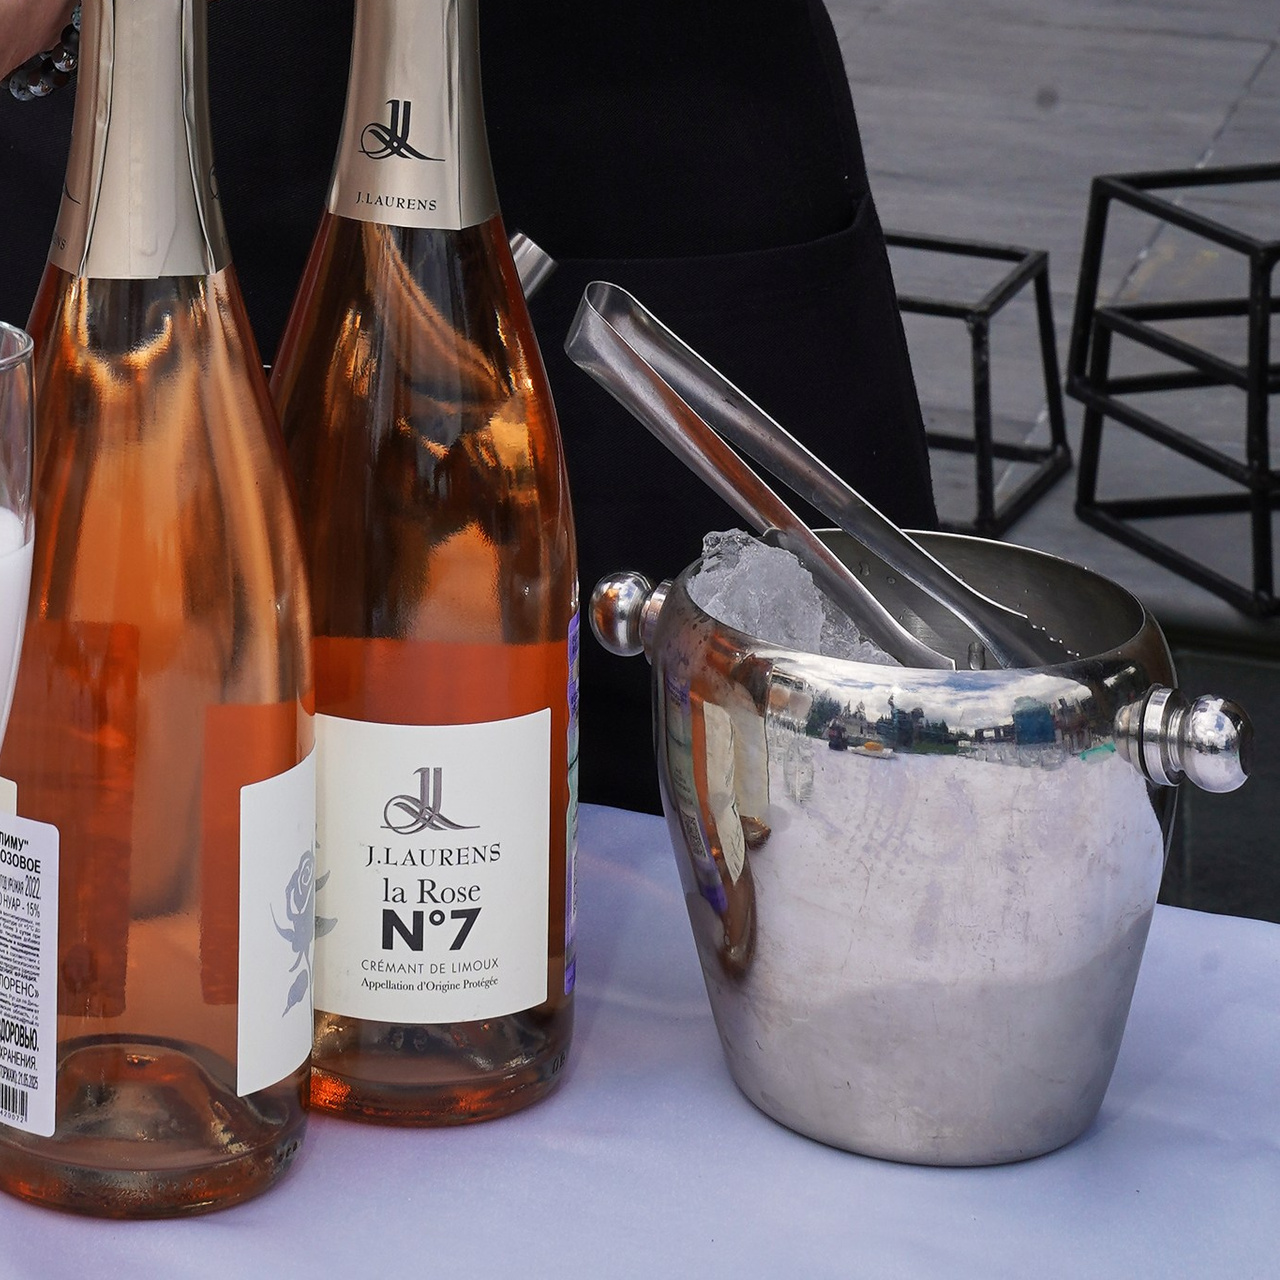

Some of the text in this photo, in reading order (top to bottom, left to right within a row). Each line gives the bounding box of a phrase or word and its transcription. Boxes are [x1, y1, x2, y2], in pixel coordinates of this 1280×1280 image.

[355, 191, 438, 211] J.LAURENS
[365, 842, 501, 868] J.LAURENS
[382, 877, 482, 905] la Rose
[360, 955, 499, 975] CRÉMANT DE LIMOUX
[360, 977, 415, 993] Appellation
[463, 976, 499, 991] Protégée
